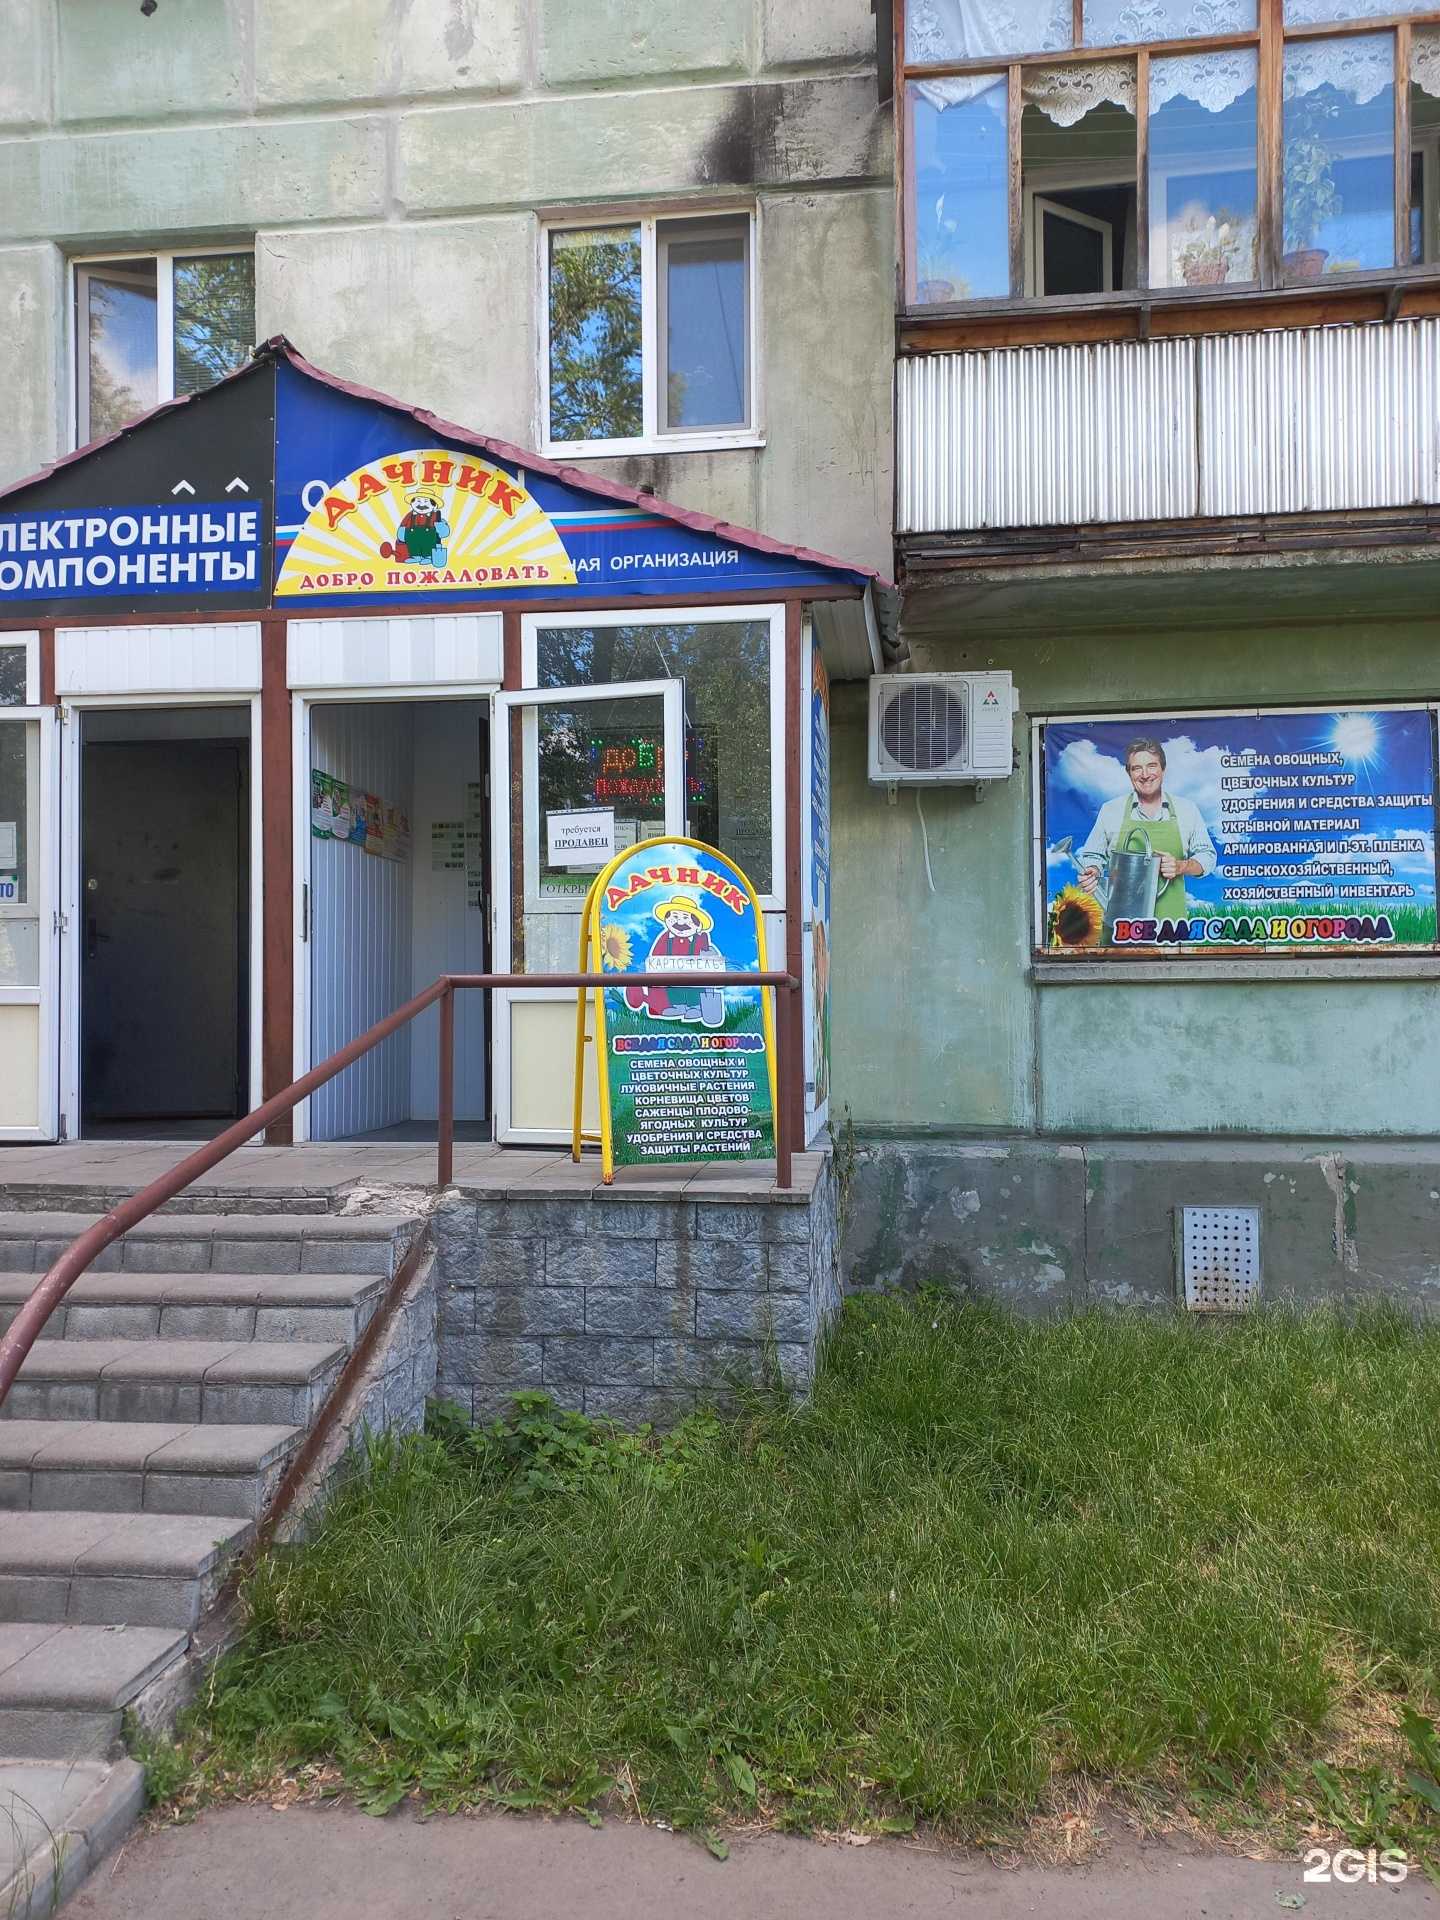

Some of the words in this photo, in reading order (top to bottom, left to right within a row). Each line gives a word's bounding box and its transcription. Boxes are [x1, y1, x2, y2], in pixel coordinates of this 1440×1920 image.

[324, 459, 527, 530] ДАЧНИК
[610, 550, 739, 570] ОРГАНИЗАЦИЯ
[0, 549, 256, 591] ОМПОНЕНТЫ
[300, 572, 374, 590] ДОБРО
[387, 564, 550, 586] ПОЖАЛОВАТЬ
[1221, 754, 1271, 767] СЕМЕНА
[1274, 752, 1344, 767] ОВОЩНЫХ,
[1222, 775, 1299, 791] ЦВЕТОЧНЫХ
[1302, 774, 1355, 788] КУЛЬТУР
[1222, 798, 1295, 813] УДОБРЕНИЯ
[1298, 798, 1307, 809] И
[1310, 795, 1375, 810] СРЕДСТВА
[1377, 794, 1433, 808] ЗАЩИТЫ
[560, 824, 601, 835] требуется
[1223, 818, 1291, 833] УКРЫВНОЙ
[1294, 819, 1360, 831] МАТЕРИАЛ
[554, 837, 609, 848] ПРОДАВЕЦ
[1223, 841, 1324, 855] АРМИРОВАННАЯ
[1327, 841, 1336, 853] И
[1374, 839, 1424, 851] ПЛЕНКА
[1223, 861, 1394, 877] СЕЛЬСКОХОЗЯЙСТВЕННЫЙ,
[607, 867, 750, 914] ДАЧНИК
[1224, 884, 1334, 899] ХОЗЯЙСТВЕННЫЙ
[1340, 885, 1415, 897] ИНВЕНТАРЬ
[1115, 920, 1157, 940] ВСЕ
[1157, 919, 1206, 942] ДЛЯ
[1207, 919, 1268, 941] САДА
[1271, 919, 1288, 939] И
[1290, 917, 1394, 941] ОГОРОДА
[615, 1037, 639, 1051] ВСЕ
[667, 1036, 700, 1051] САДА
[701, 1036, 710, 1049] И
[630, 1059, 675, 1069] СЕМЕНА
[676, 1057, 735, 1068] ОВОЩНЫХ
[736, 1058, 745, 1067] И
[631, 1071, 701, 1082] ЦВЕТОЧНЫХ
[703, 1069, 749, 1080] КУЛЬТУР
[620, 1083, 697, 1094] ЛУКОВИЧНЫЕ
[699, 1081, 755, 1091] РАСТЕНИЯ
[635, 1094, 704, 1106] КОРНЕВИЩА
[707, 1093, 750, 1104] ЦВЕТОВ
[635, 1106, 693, 1118] САЖЕНЦЫ
[696, 1105, 752, 1116] ПЛОДОВО-
[640, 1119, 695, 1131] ЯГОДНЫХ
[701, 1118, 748, 1129] КУЛЬТУР
[626, 1131, 693, 1144] УДОБРЕНИЯ
[695, 1131, 704, 1140] И
[706, 1129, 763, 1141] СРЕДСТВА
[640, 1144, 691, 1156] ЗАЩИТЫ
[693, 1141, 751, 1153] РАСТЕНИЙ
